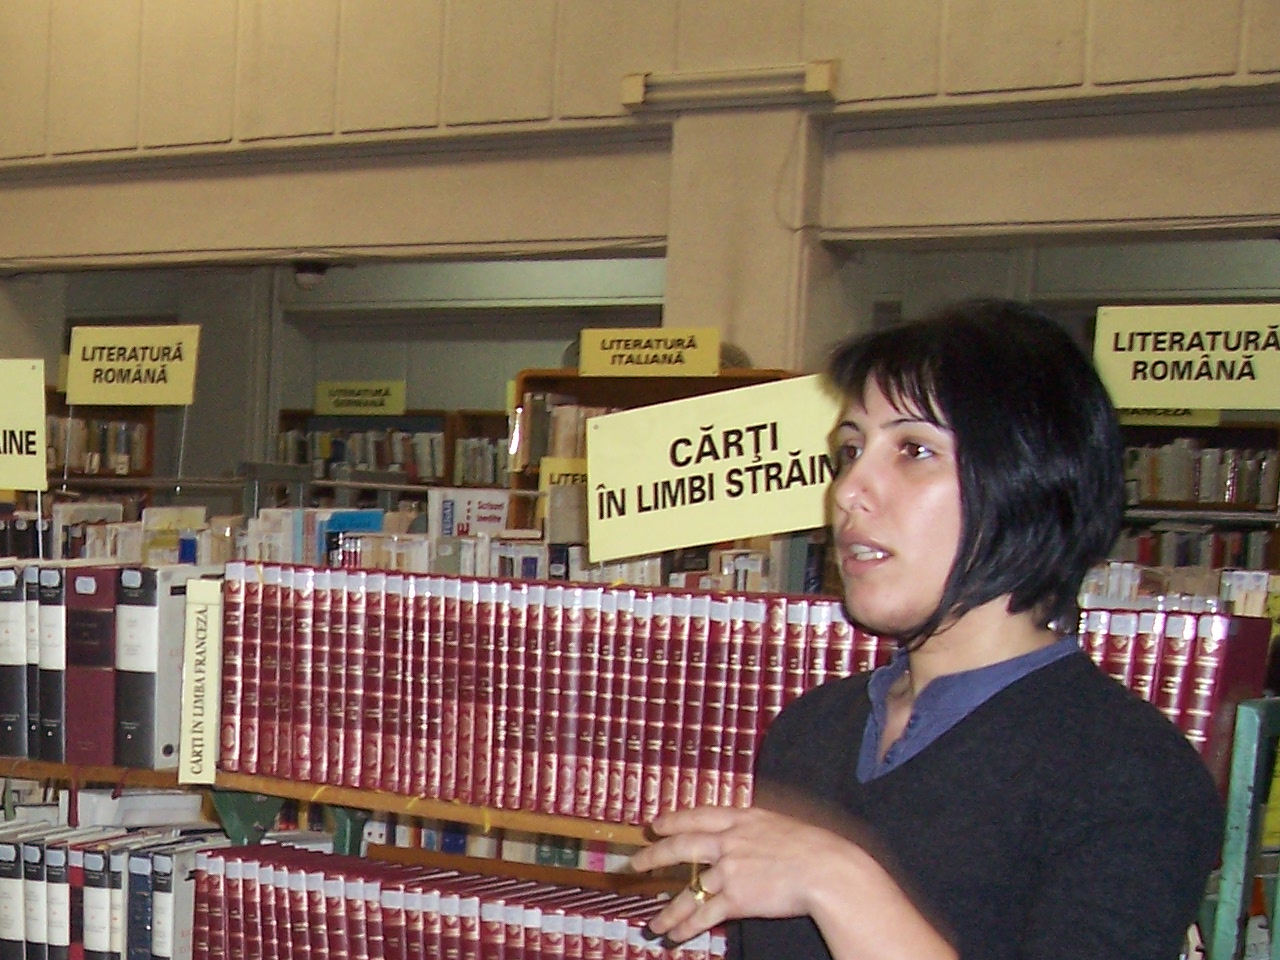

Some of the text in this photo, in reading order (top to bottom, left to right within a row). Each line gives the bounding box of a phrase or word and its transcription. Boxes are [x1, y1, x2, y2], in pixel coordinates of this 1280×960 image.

[81, 342, 184, 362] LITERATURĂ
[1112, 325, 1280, 353] LITERATURĂ
[92, 363, 169, 384] ROMÂNĂ
[1131, 354, 1256, 381] ROMÂNĂ
[596, 450, 837, 520] ÎN LIMBI STRĂIN
[192, 677, 206, 717] LIMBA
